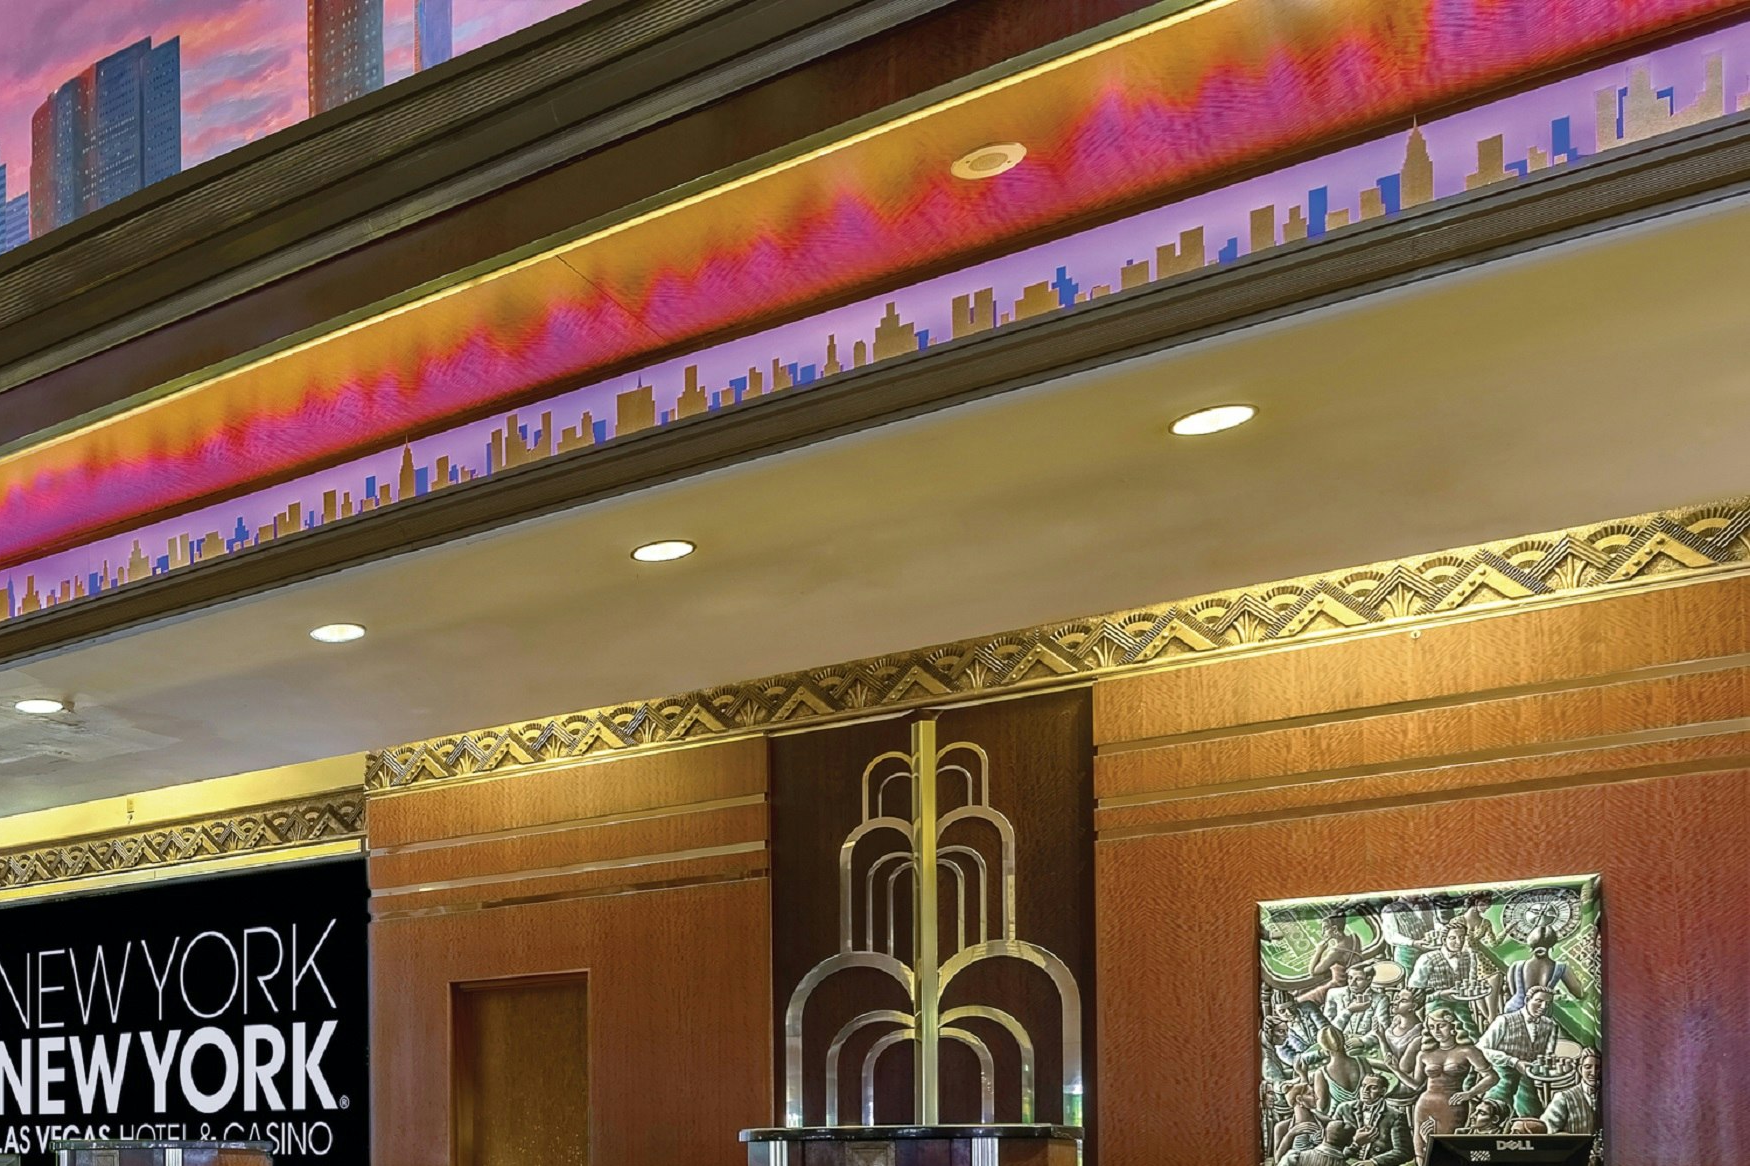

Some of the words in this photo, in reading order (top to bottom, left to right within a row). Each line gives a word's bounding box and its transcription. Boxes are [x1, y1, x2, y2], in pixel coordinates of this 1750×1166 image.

[141, 918, 337, 1021] YORK
[224, 1121, 334, 1156] CASINO
[1496, 1140, 1534, 1150] DELL
